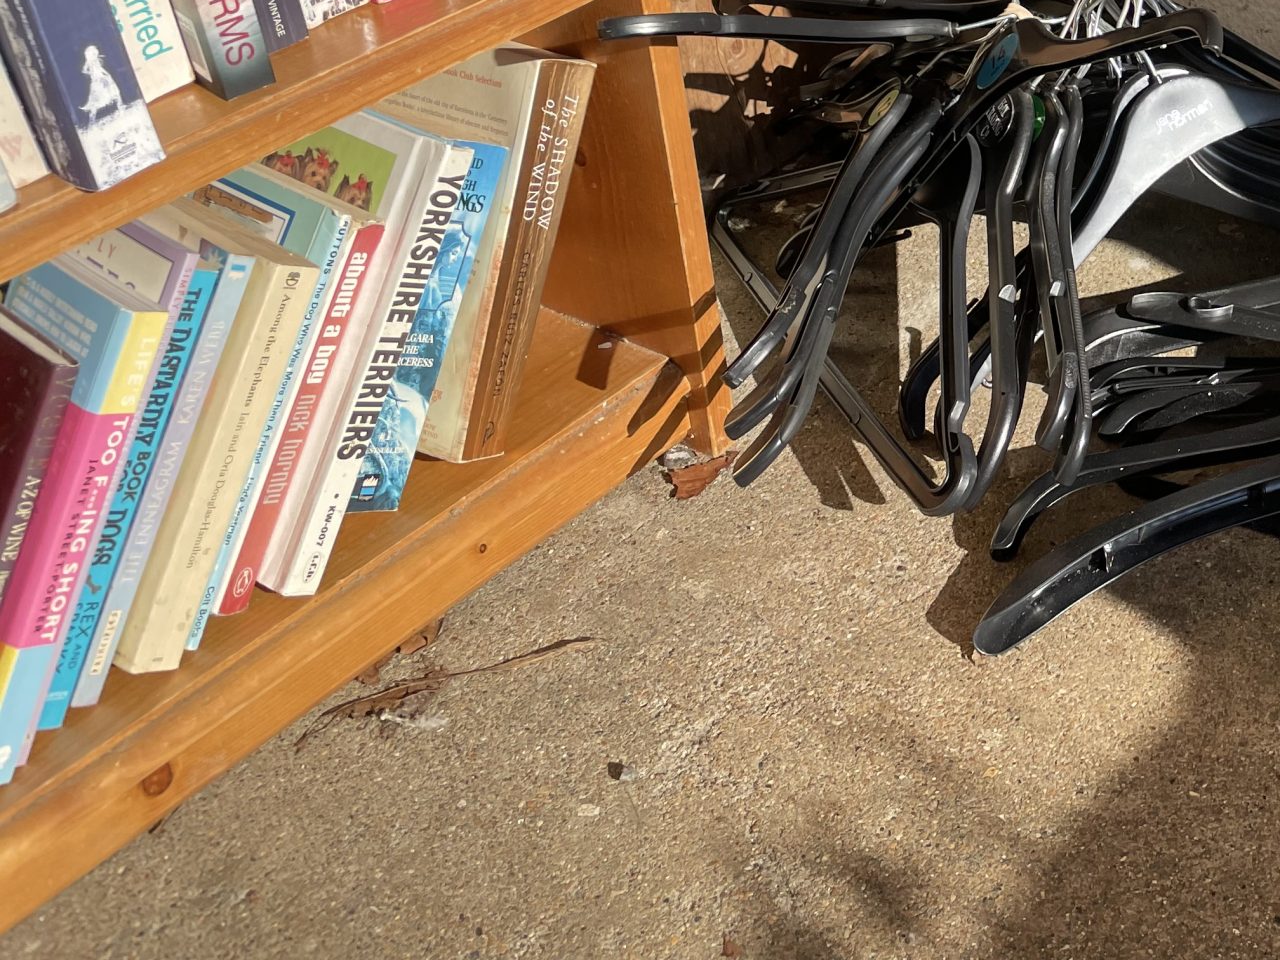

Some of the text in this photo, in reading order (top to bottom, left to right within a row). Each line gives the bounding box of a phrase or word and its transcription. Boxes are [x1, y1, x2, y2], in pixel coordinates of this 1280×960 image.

[523, 98, 557, 221] of the WIND
[537, 95, 580, 231] The SHADOW
[386, 174, 468, 324] YORKSHIRE
[314, 283, 327, 300] The
[269, 295, 291, 333] Among
[304, 301, 319, 321] Dog
[264, 336, 276, 354] the
[297, 322, 314, 346] Who
[290, 348, 302, 371] Was
[122, 288, 202, 502] THE DASTARDLY BOOK
[244, 356, 269, 407] Elephants
[263, 252, 368, 506] about a boy nick hornby
[280, 370, 293, 396] More
[337, 332, 408, 461] TERRIERS
[270, 397, 285, 425] Than
[101, 417, 131, 466] TOO
[229, 433, 241, 452] and
[255, 435, 270, 465] Friend
[15, 502, 34, 521] OF
[316, 505, 336, 547] KW-007
[1, 524, 26, 562] WINE
[34, 460, 98, 633] JANET STREET-PORTER
[40, 562, 78, 642] SHORT
[68, 601, 99, 669] REX AND
[191, 608, 208, 639] Books
